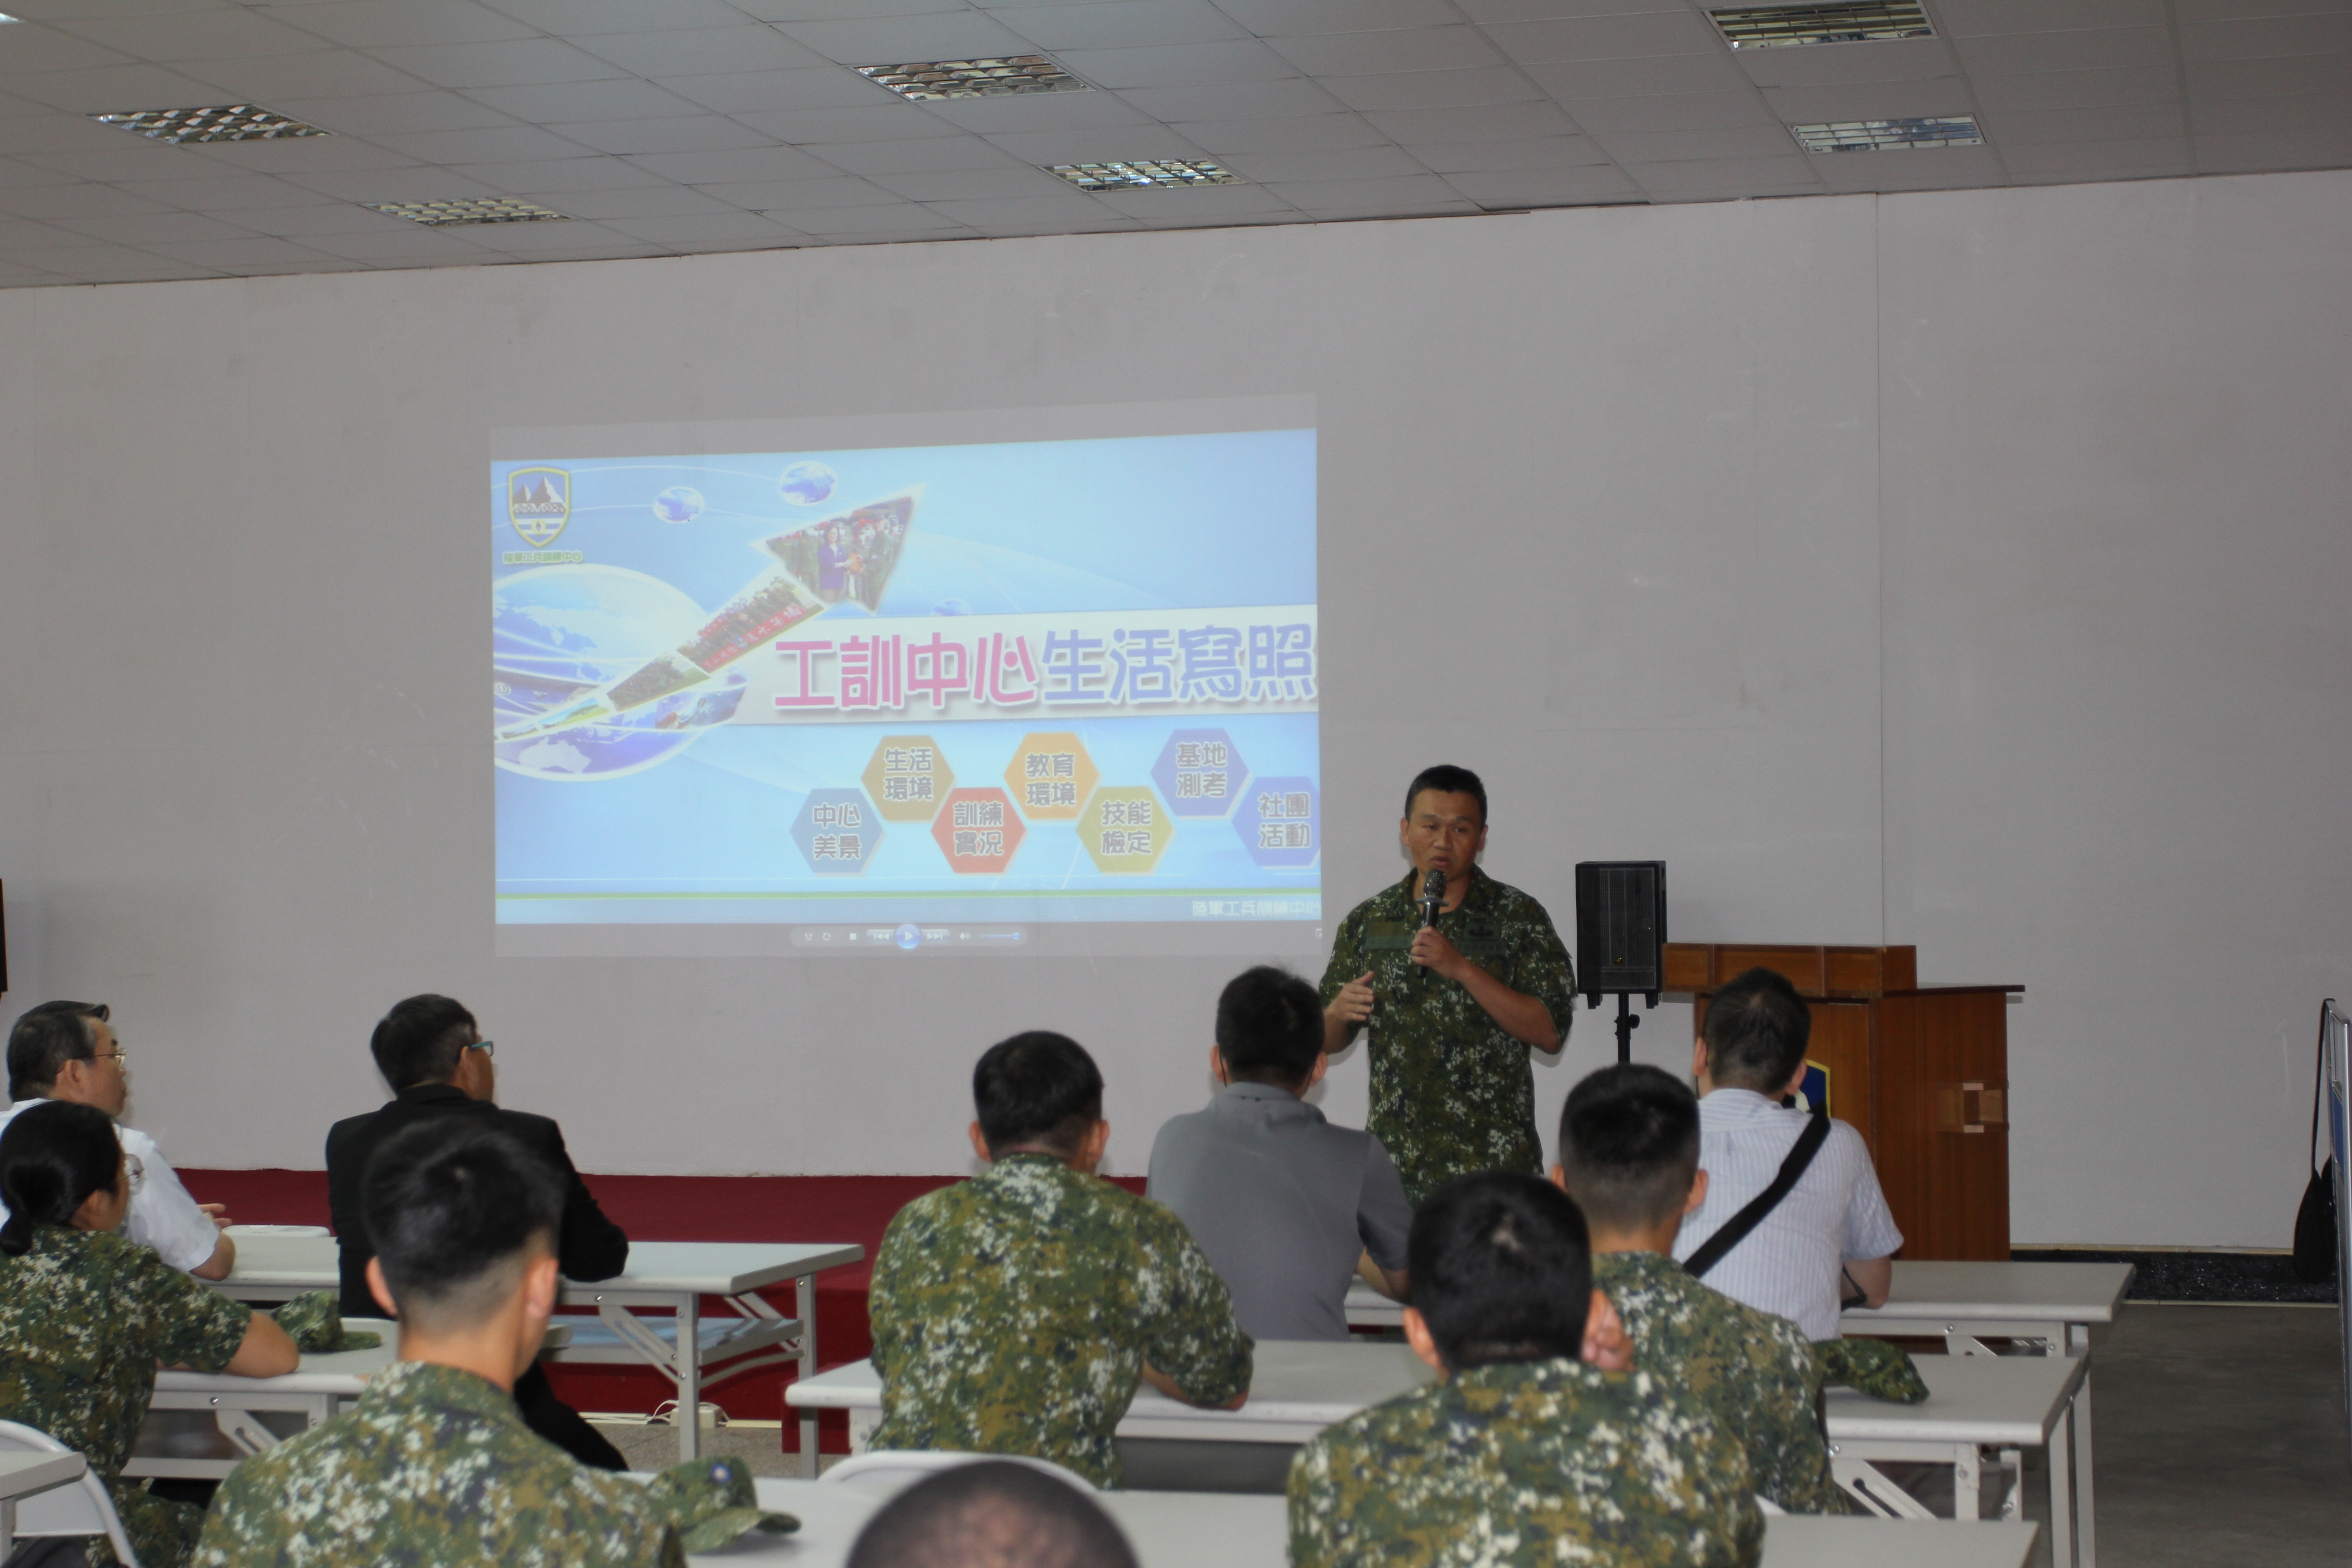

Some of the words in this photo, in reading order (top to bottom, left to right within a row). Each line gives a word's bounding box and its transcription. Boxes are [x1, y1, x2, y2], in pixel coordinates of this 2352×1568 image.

[775, 623, 1315, 707] 工訓中心生活寫照
[884, 747, 932, 772] 生活
[1025, 753, 1076, 778] 教育
[1176, 741, 1227, 768] 基地
[884, 776, 933, 801] 環境
[1025, 781, 1076, 807] 環境
[1176, 771, 1227, 798] 測考
[813, 803, 861, 828] 中心
[954, 801, 1004, 826] 訓練
[1101, 800, 1152, 826] 技能
[1258, 792, 1310, 818] 社團
[813, 834, 861, 859] 美景
[954, 831, 1004, 856] 實況
[1101, 829, 1152, 855] 檢定
[1258, 822, 1311, 848] 活動
